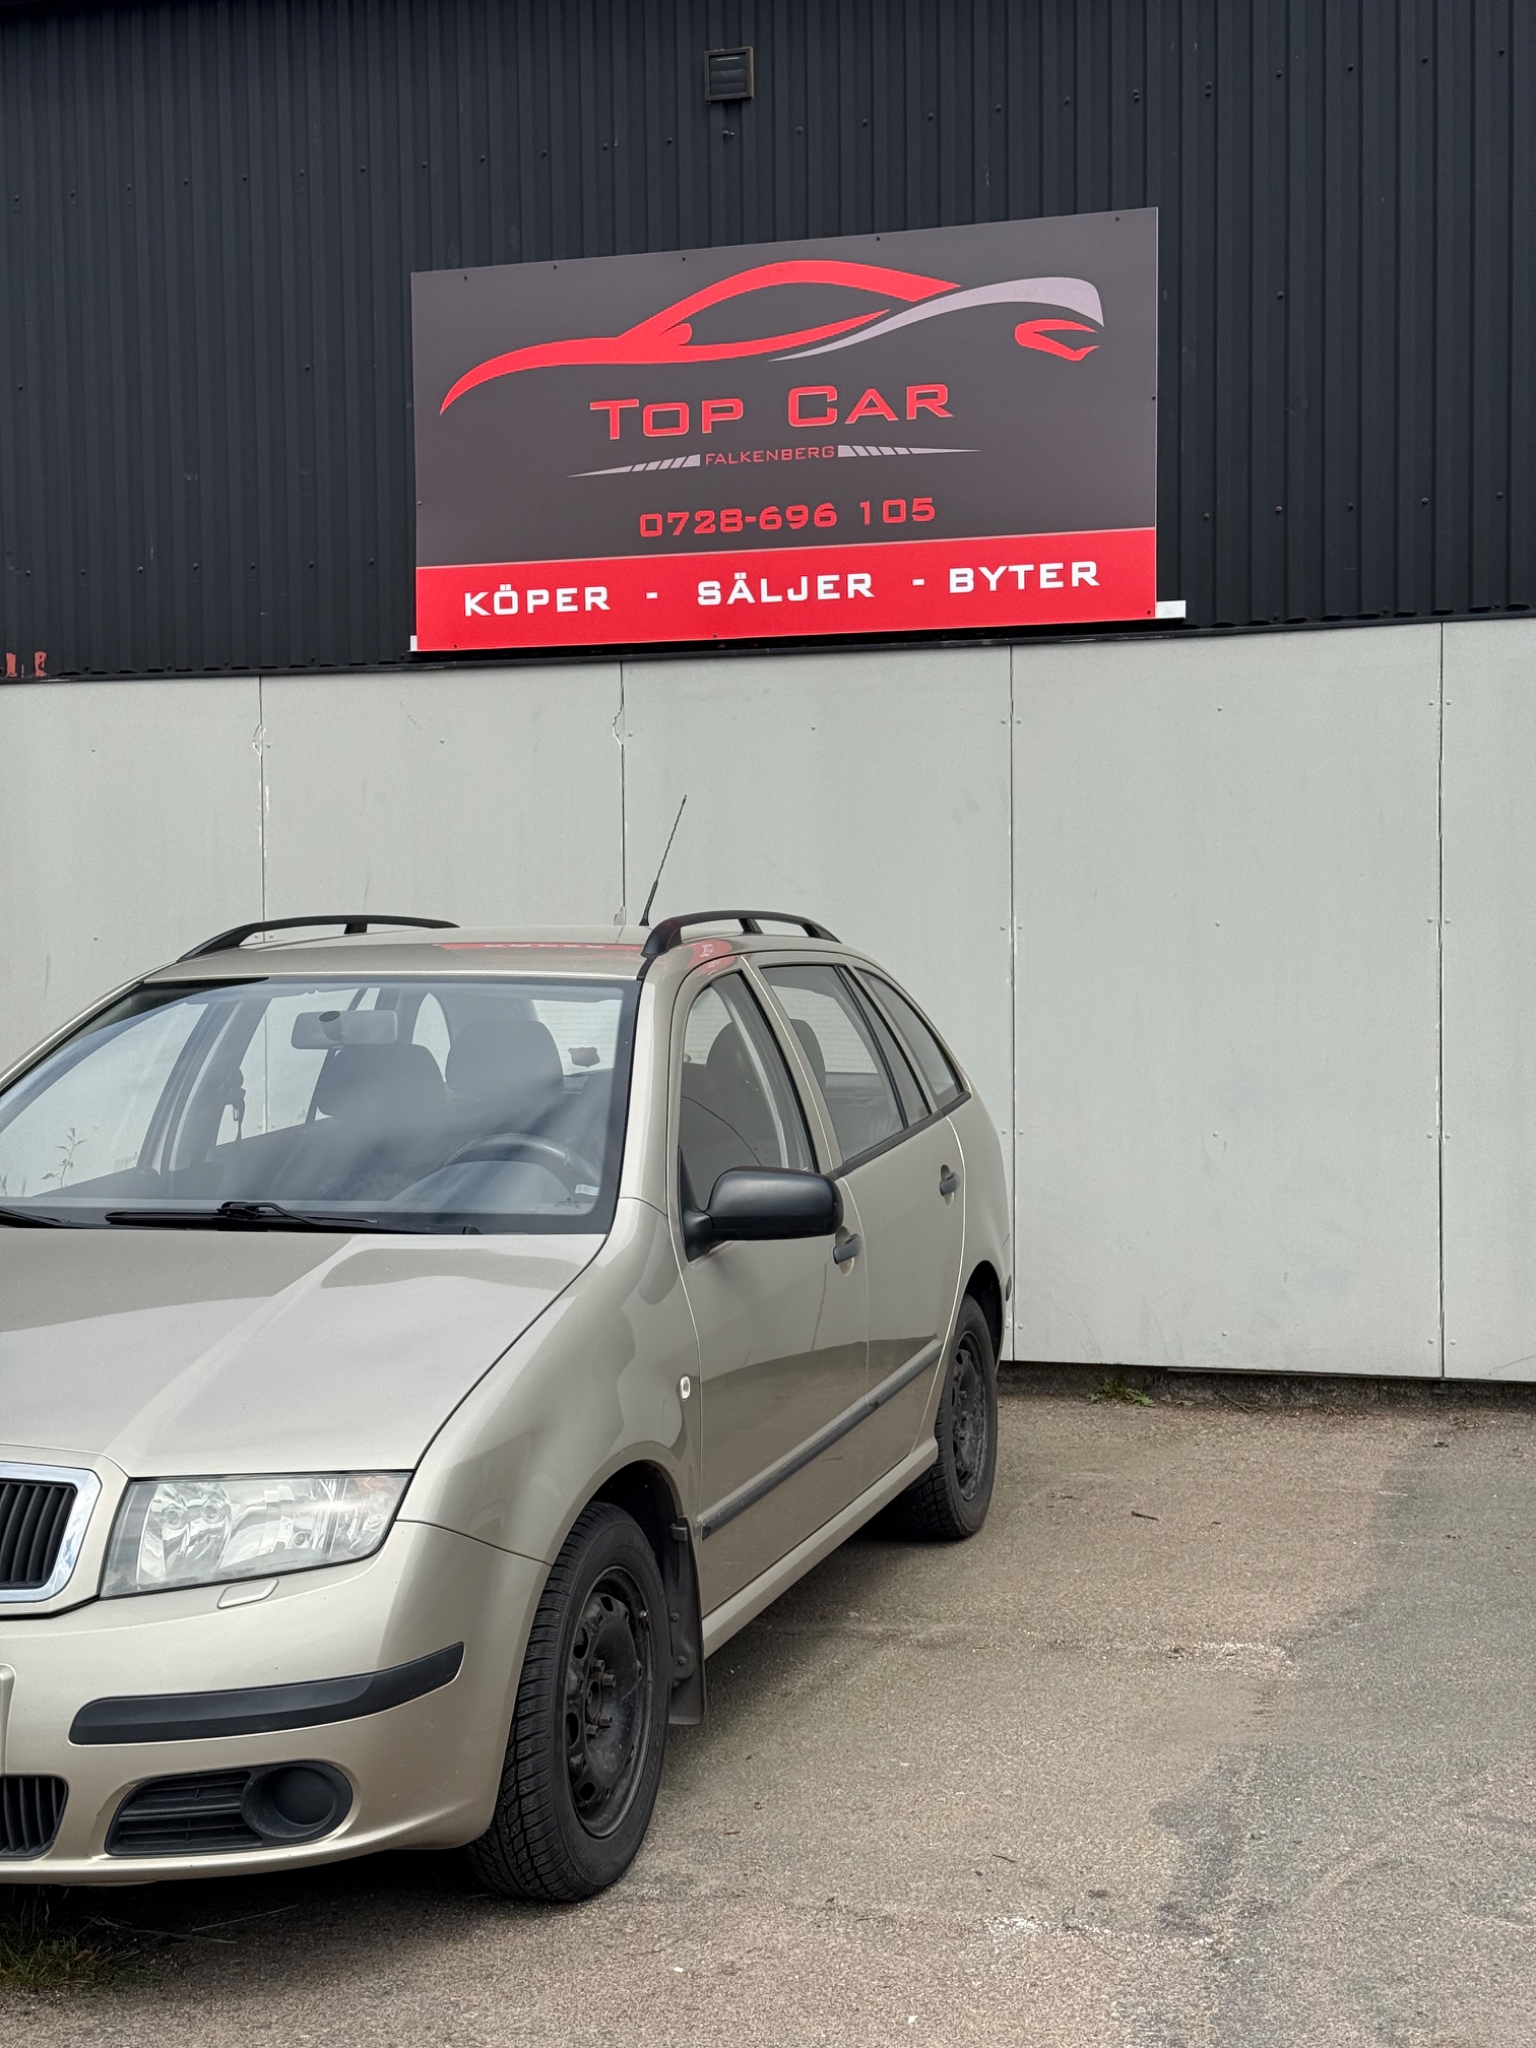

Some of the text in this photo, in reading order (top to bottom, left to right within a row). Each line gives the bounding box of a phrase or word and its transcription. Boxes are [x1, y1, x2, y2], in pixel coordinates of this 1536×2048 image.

[589, 383, 953, 441] TOP CAR
[704, 444, 835, 466] FALKENBERG
[638, 496, 936, 539] 0728-696 105
[464, 583, 611, 617] KÖPER
[697, 572, 875, 606] SÄLJER
[949, 560, 1100, 594] BYTER
